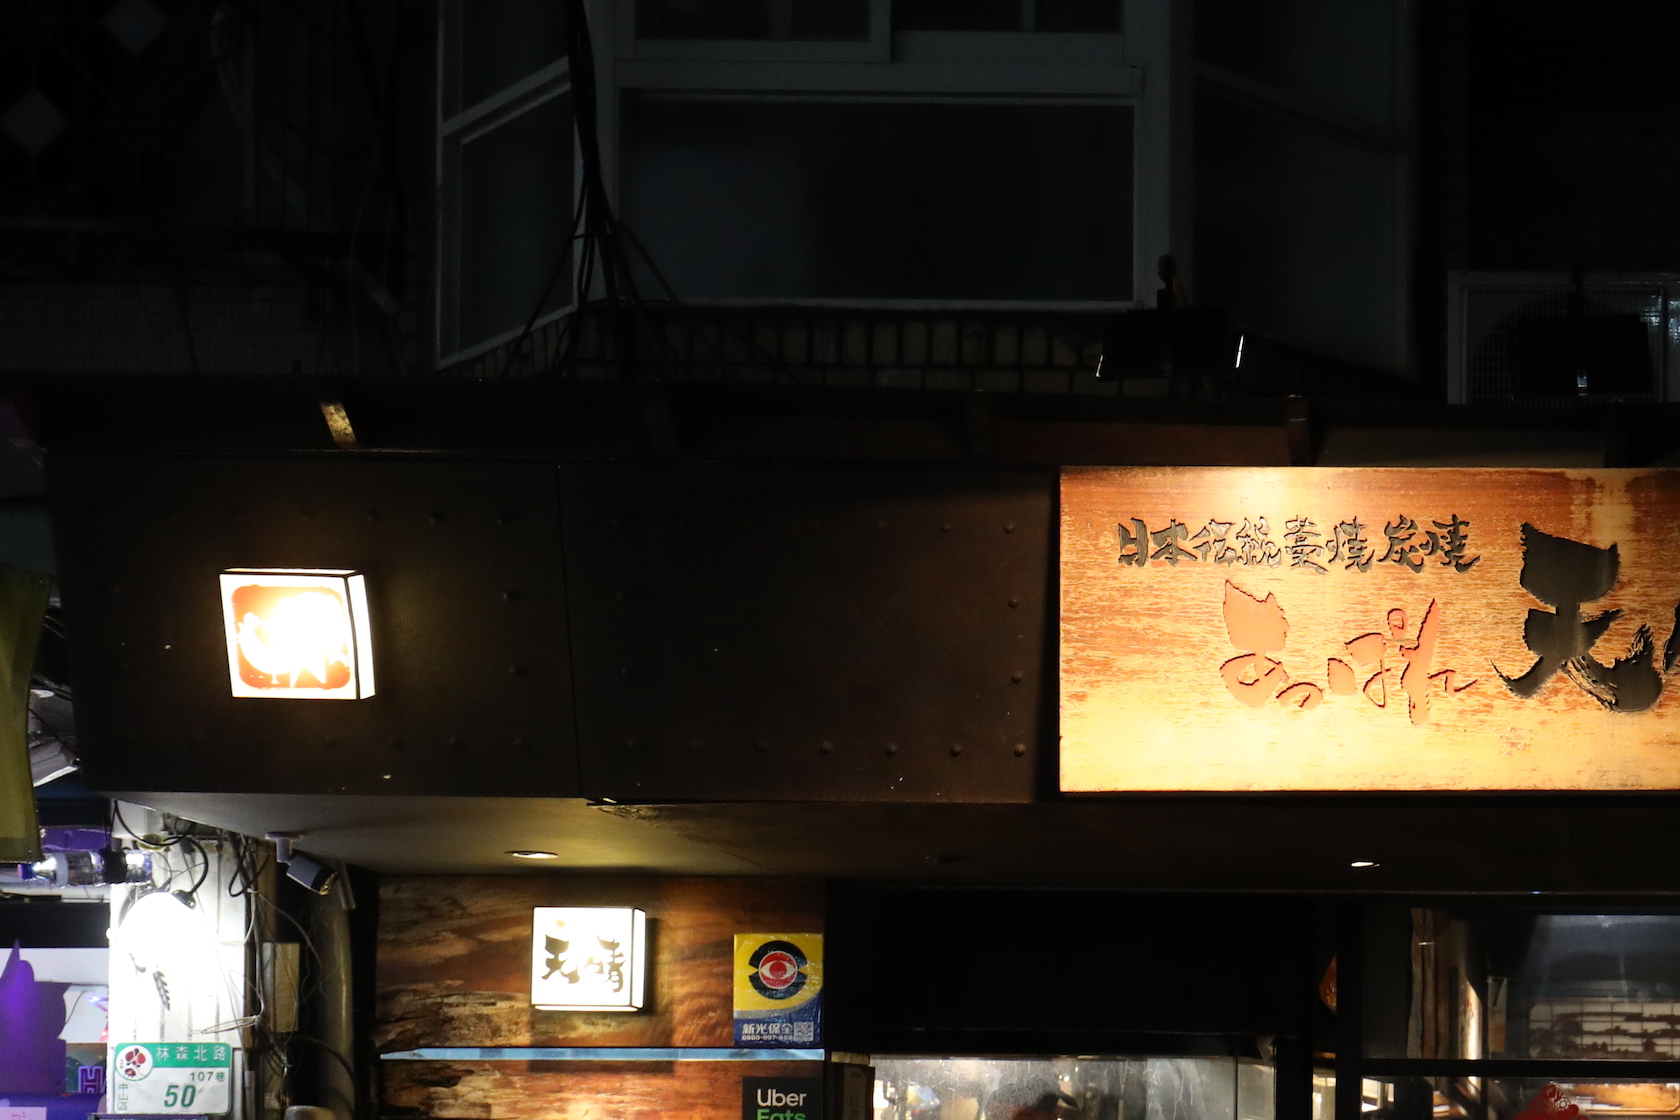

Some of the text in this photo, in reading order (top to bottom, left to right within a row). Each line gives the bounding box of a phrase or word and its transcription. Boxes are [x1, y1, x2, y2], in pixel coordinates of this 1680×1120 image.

[742, 1023, 793, 1035] 新光保全
[155, 1047, 226, 1061] 林森北路
[190, 1071, 225, 1081] 107巷
[118, 1083, 128, 1110] 中山區
[163, 1085, 196, 1107] 50
[757, 1088, 807, 1107] Uber
